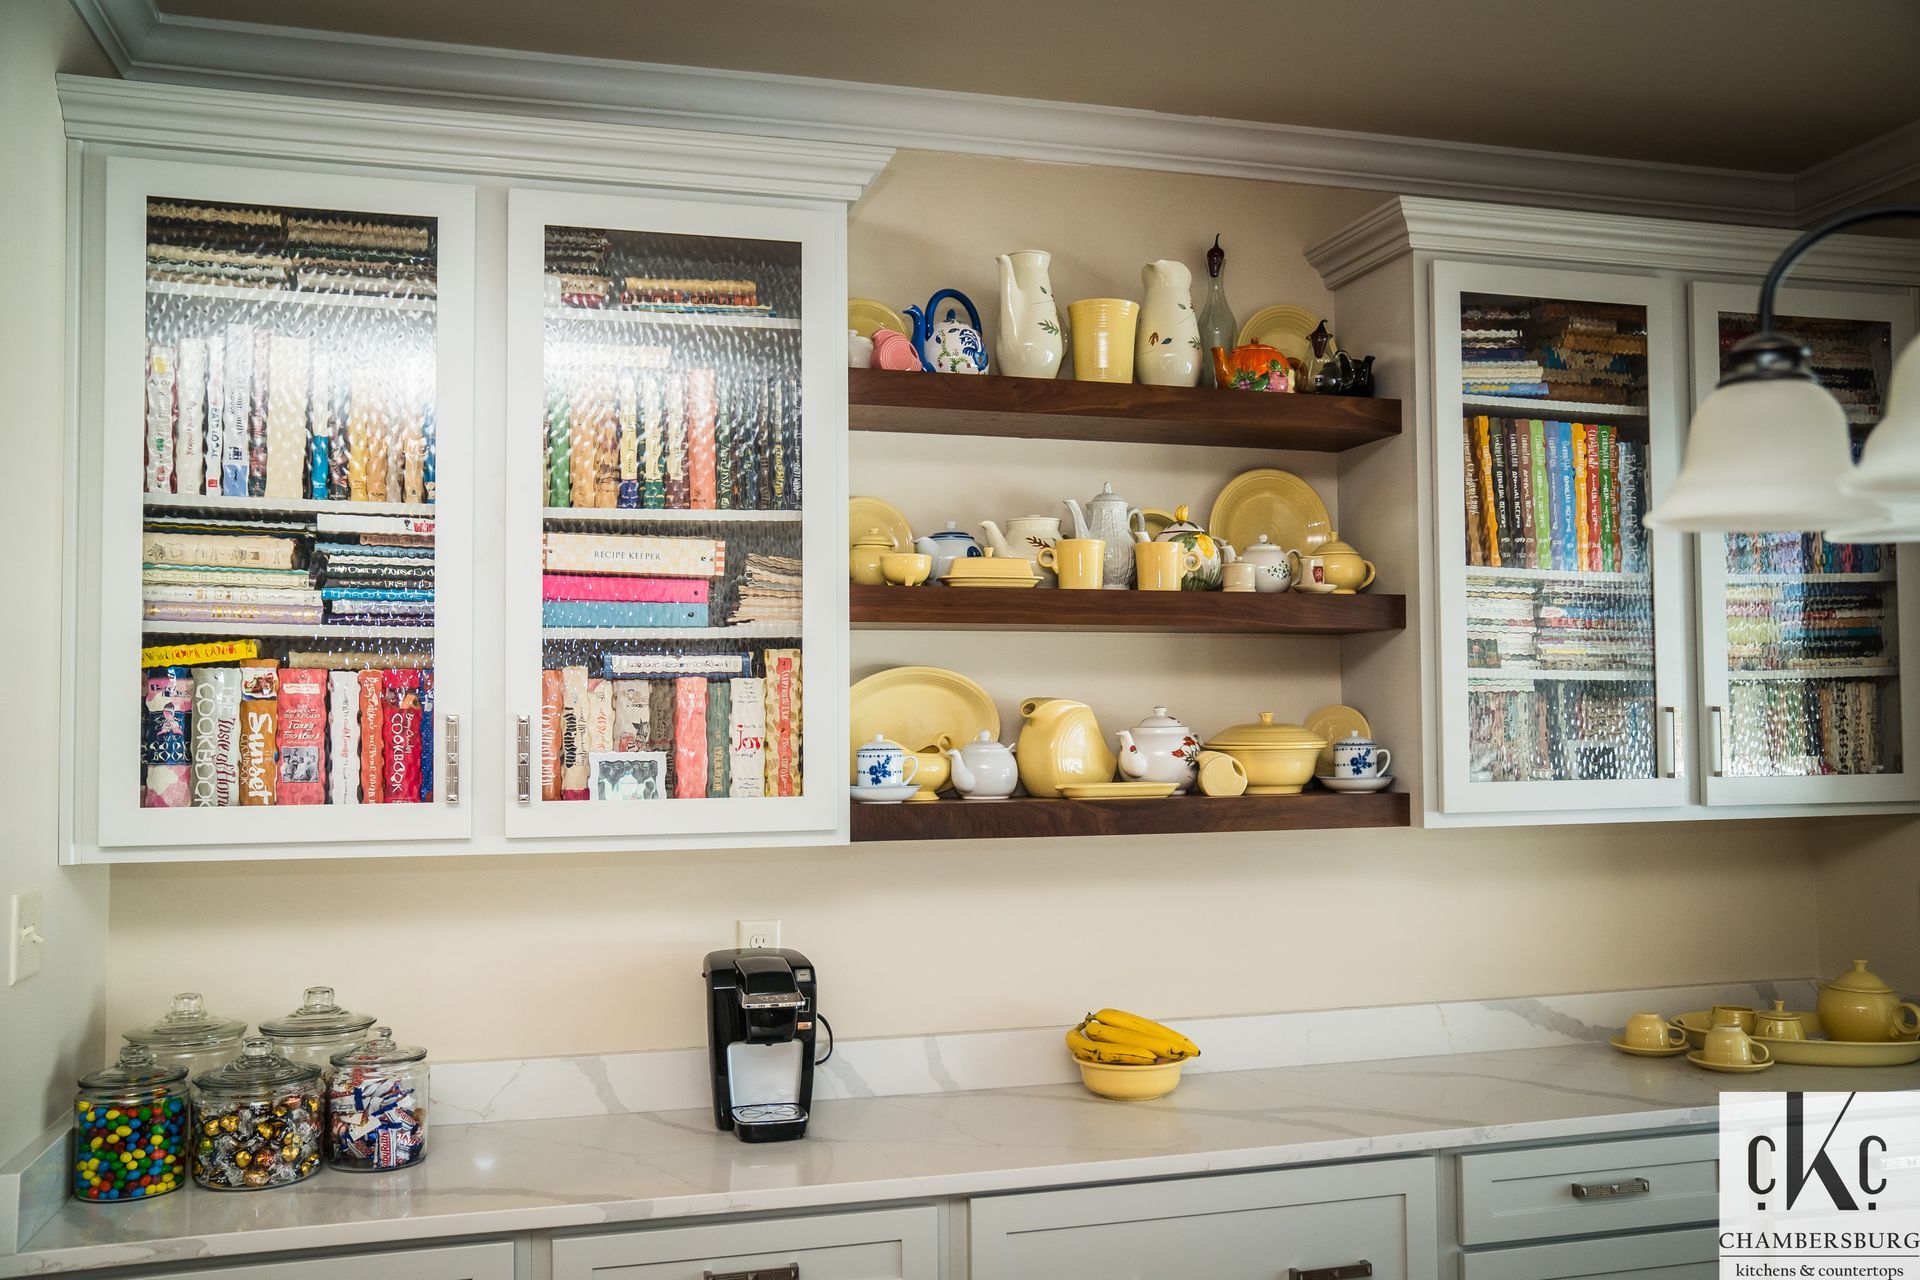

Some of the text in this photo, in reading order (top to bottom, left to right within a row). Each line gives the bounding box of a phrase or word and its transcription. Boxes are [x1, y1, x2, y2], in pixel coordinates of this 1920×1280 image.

[594, 551, 661, 561] RECIPE KEEPER
[195, 683, 215, 807] COOKBOOK
[213, 753, 236, 770] of
[218, 718, 236, 753] Taste
[248, 712, 273, 805] Sunset
[391, 713, 405, 793] COOKBOOK
